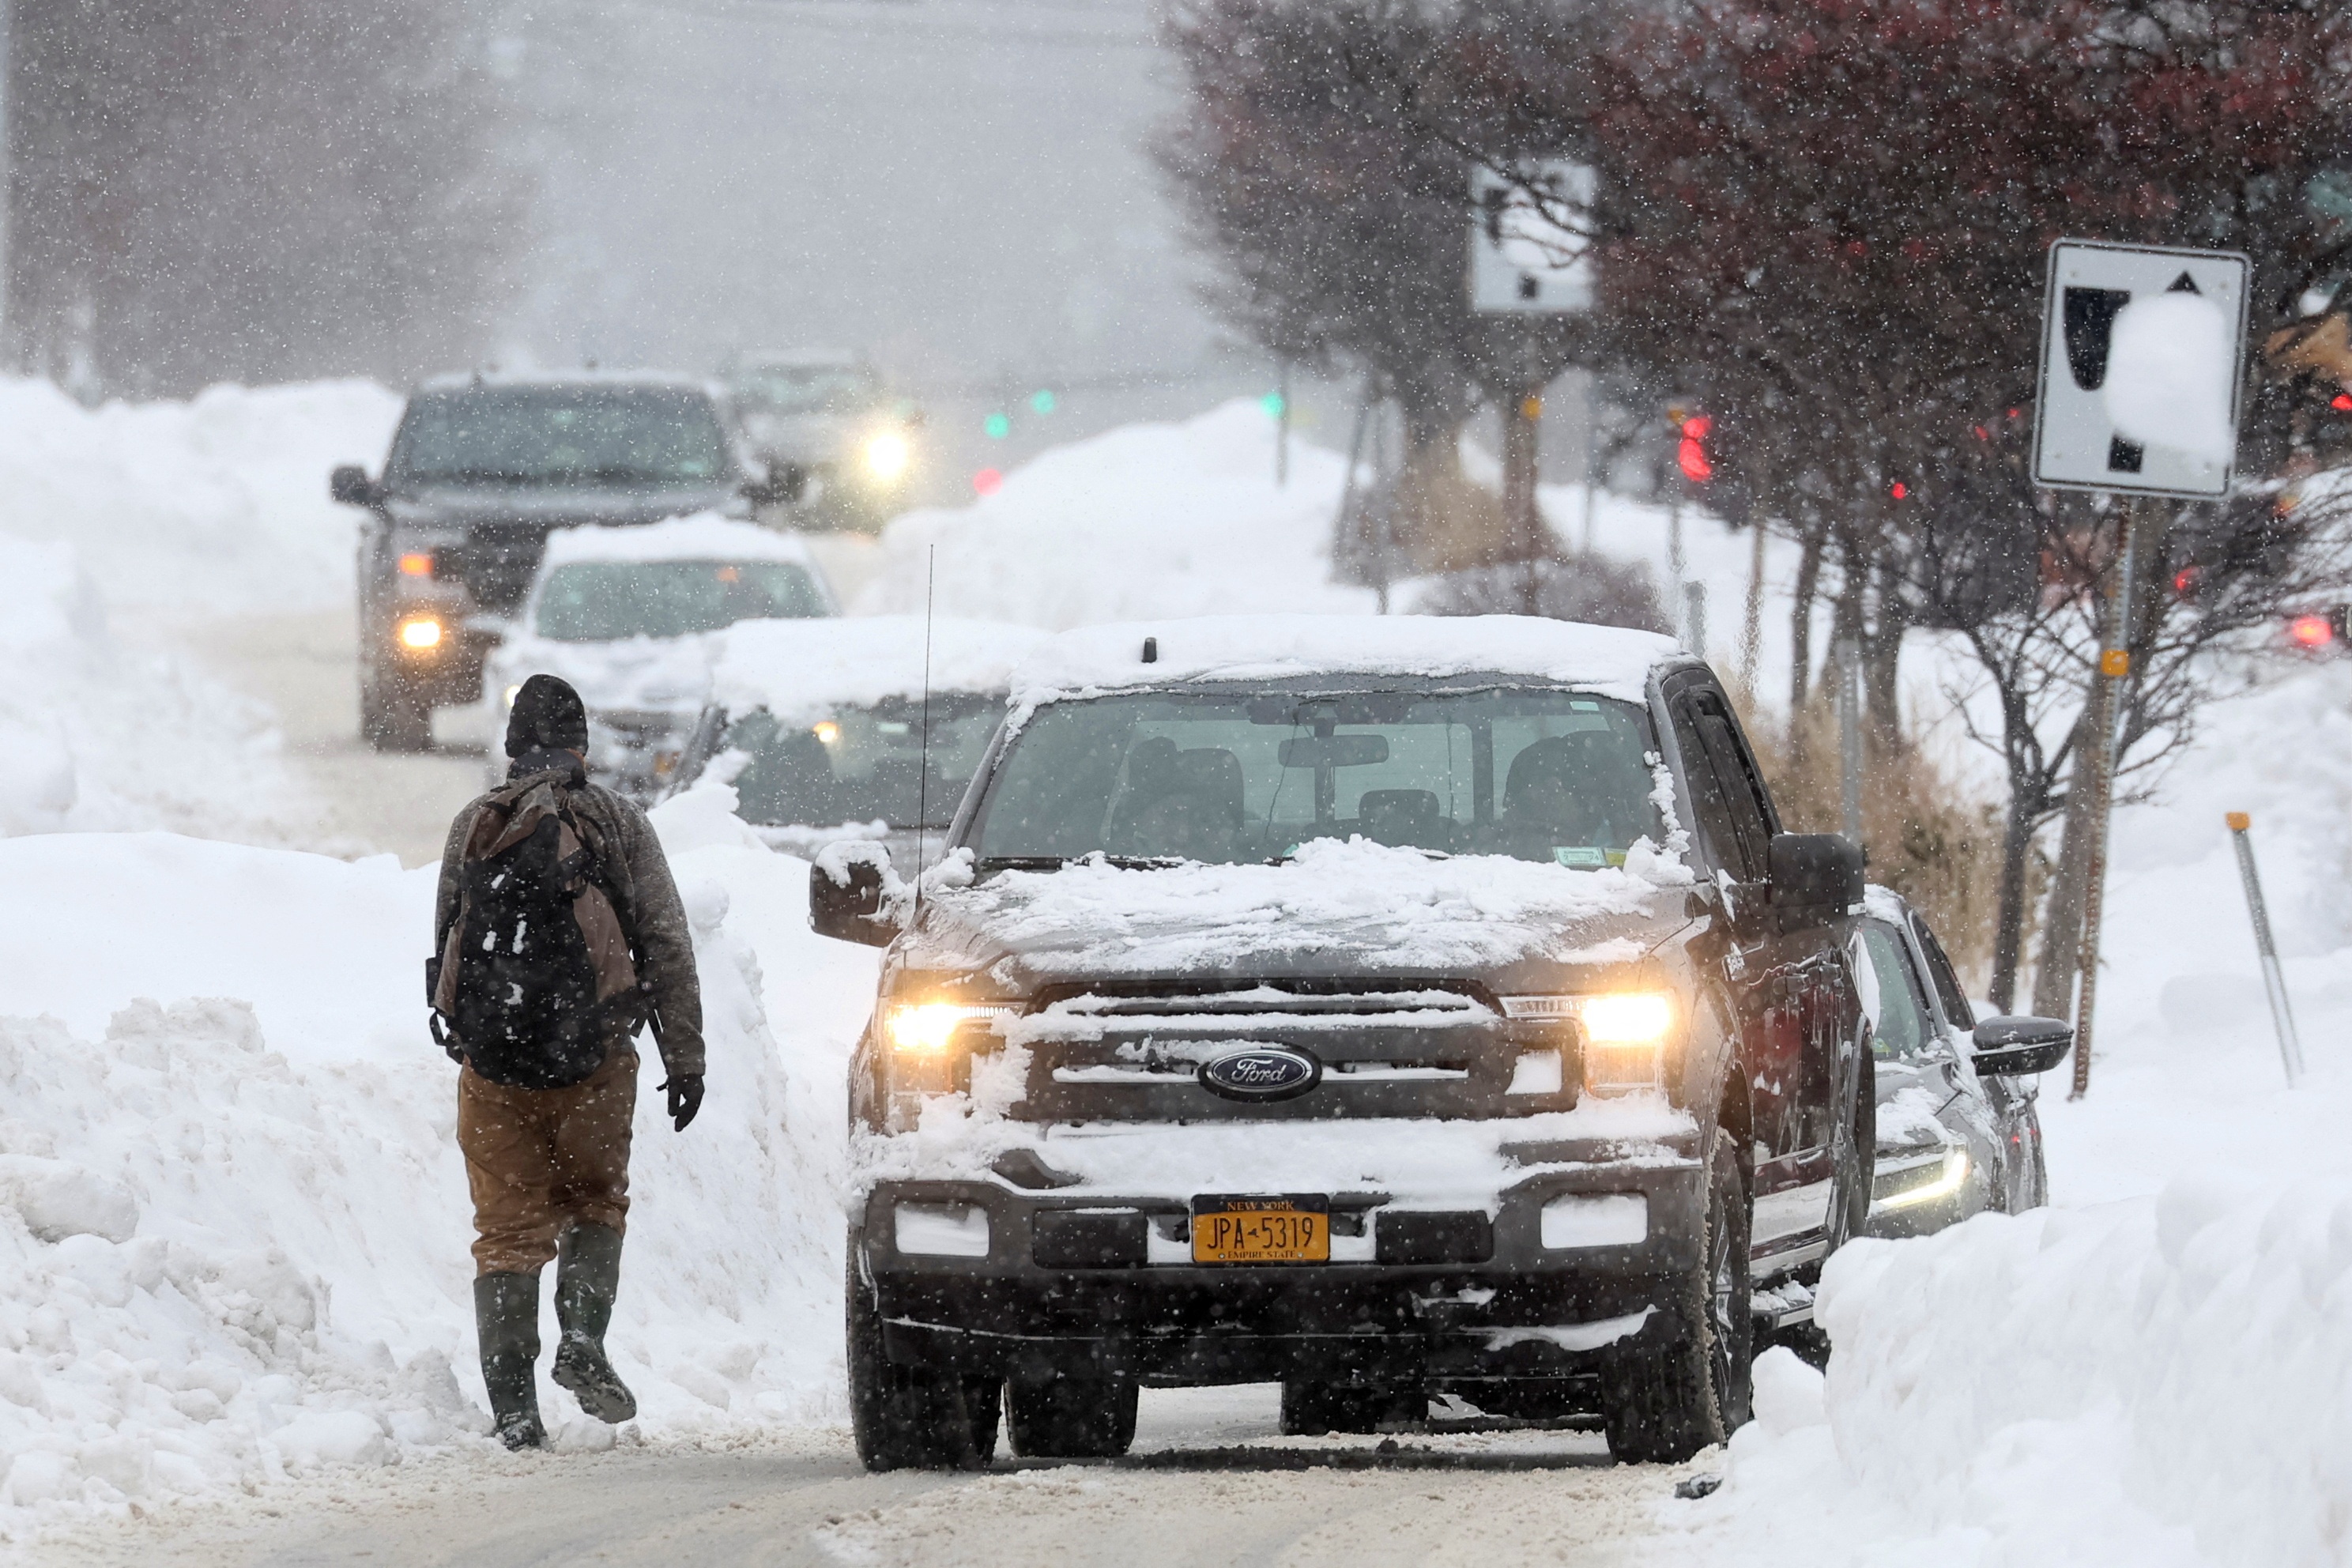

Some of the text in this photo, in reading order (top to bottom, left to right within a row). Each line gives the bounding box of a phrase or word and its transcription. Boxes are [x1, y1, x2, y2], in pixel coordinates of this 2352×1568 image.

[1231, 1058, 1287, 1082] Ford
[1227, 1201, 1294, 1211] NEW YORK
[1267, 1250, 1295, 1259] STATE
